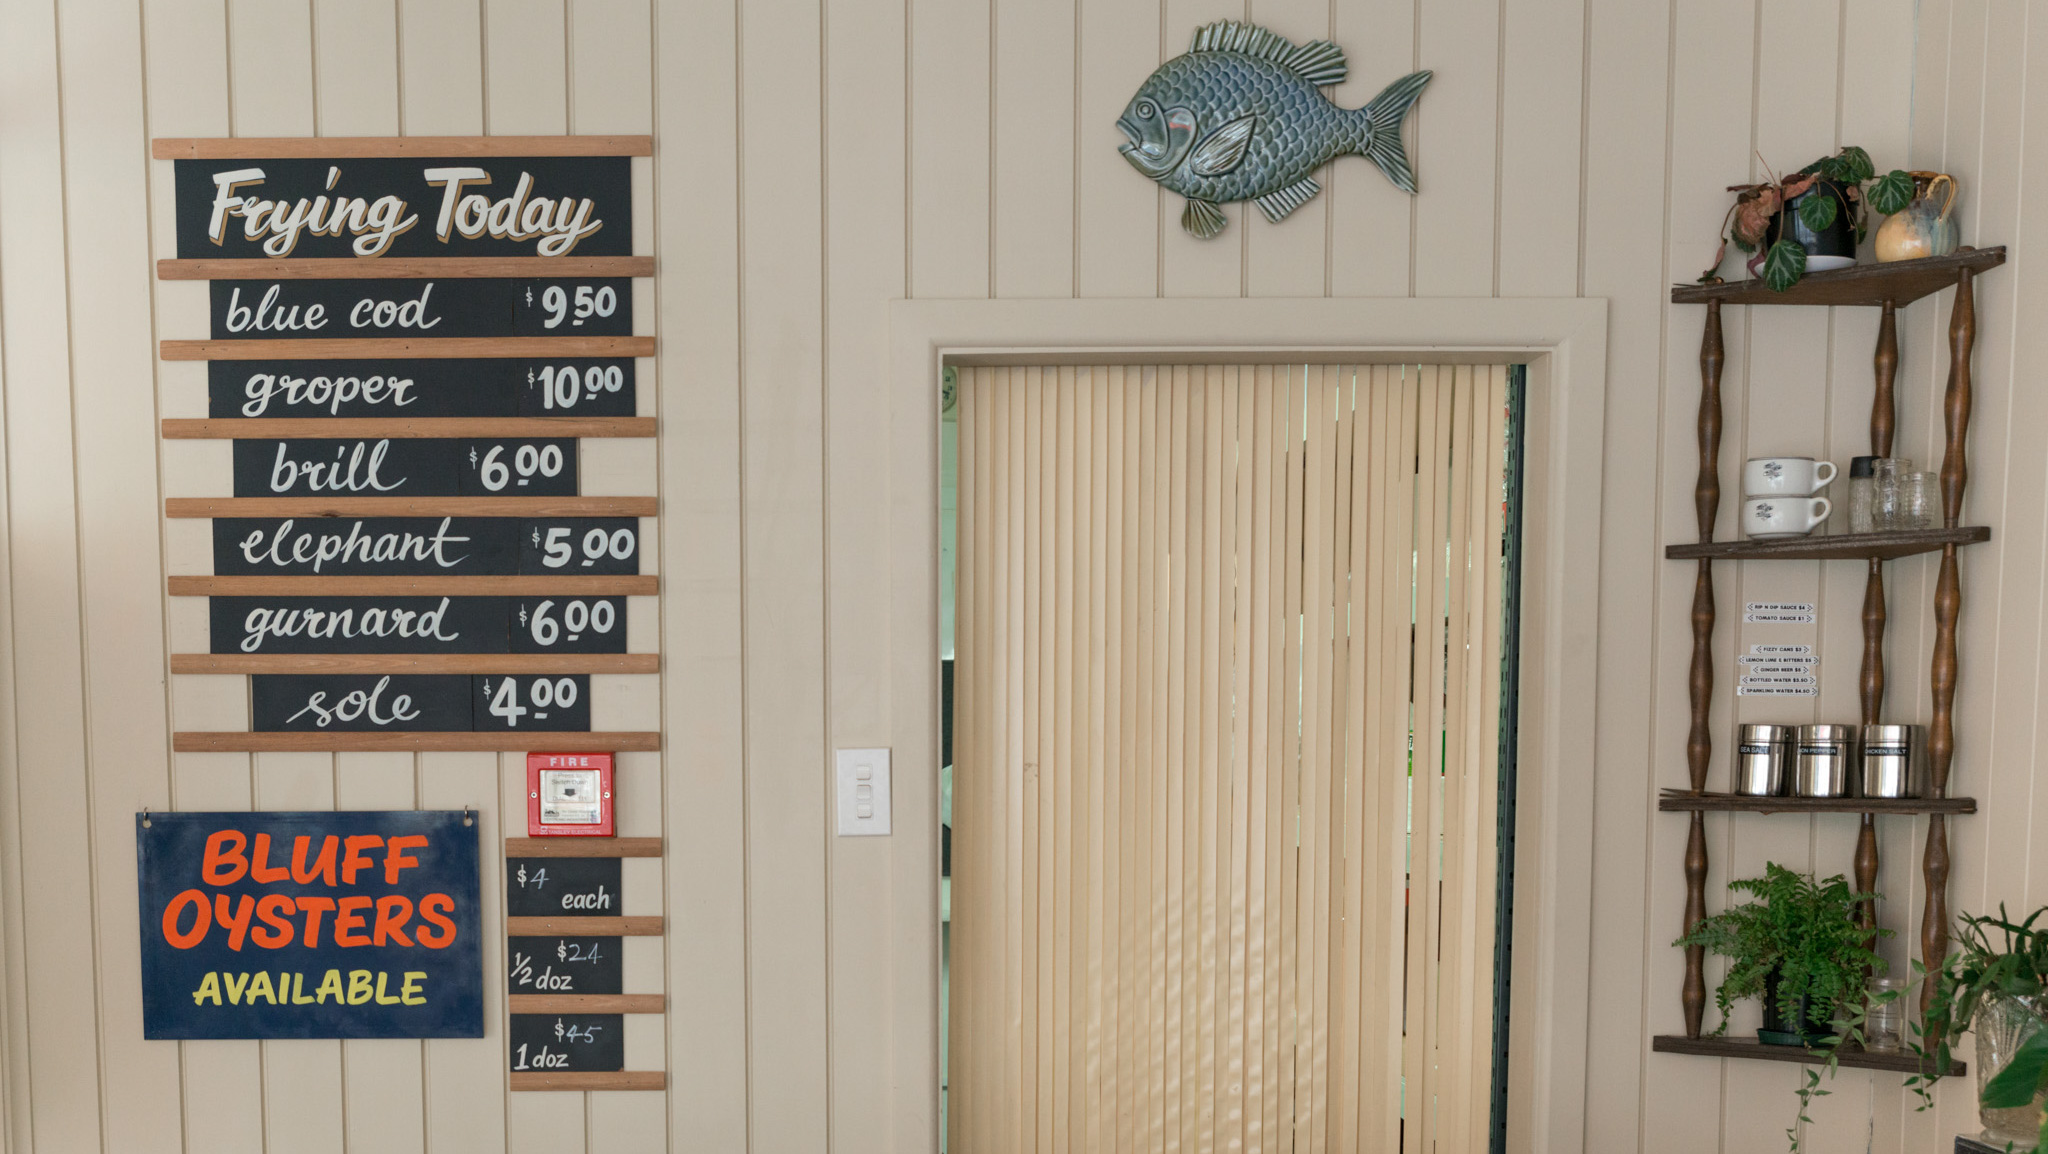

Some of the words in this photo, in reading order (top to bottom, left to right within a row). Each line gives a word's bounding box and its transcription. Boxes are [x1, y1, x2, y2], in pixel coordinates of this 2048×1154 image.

[208, 166, 418, 257] Frying
[424, 167, 606, 257] Today
[226, 284, 328, 332] blue
[350, 283, 441, 329] cod
[242, 374, 417, 417] groper
[271, 439, 406, 492] brill
[240, 516, 470, 573] elephant
[241, 597, 459, 652] gurnard
[286, 675, 420, 727] sole
[550, 757, 588, 766] FIRE
[202, 830, 429, 886] BLUFF
[517, 864, 549, 889] $4
[562, 885, 609, 909] each
[162, 889, 457, 951] OYSTERS
[558, 940, 602, 964] $24
[192, 969, 427, 1005] AVAILABLE
[536, 966, 572, 990] doz
[555, 1018, 602, 1043] $45
[514, 1043, 529, 1070] 1
[533, 1046, 568, 1067] doz
